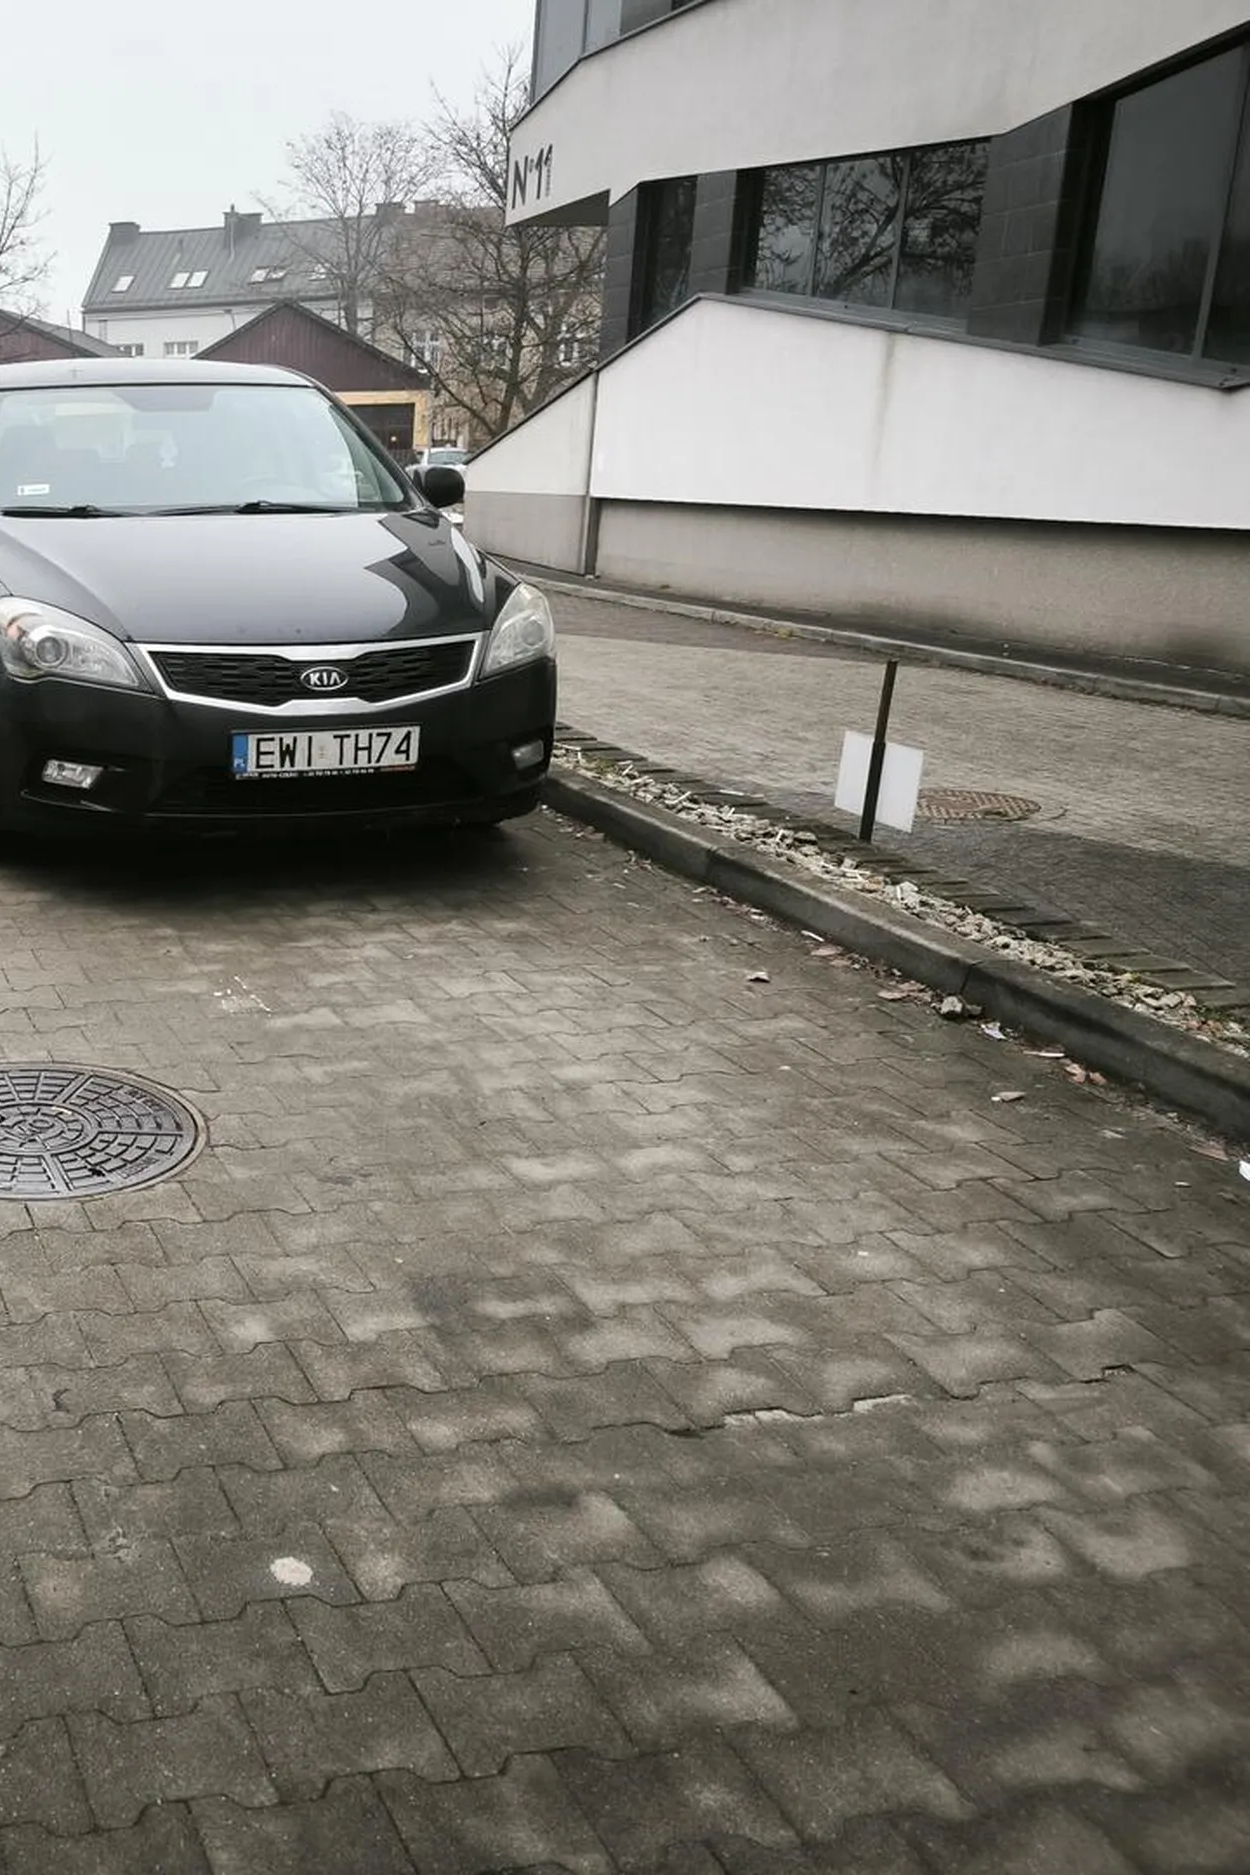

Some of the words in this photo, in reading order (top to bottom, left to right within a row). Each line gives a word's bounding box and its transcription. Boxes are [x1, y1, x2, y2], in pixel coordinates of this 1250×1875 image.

[310, 671, 341, 686] KIA
[255, 735, 313, 769] EWI
[333, 729, 412, 766] TH74
